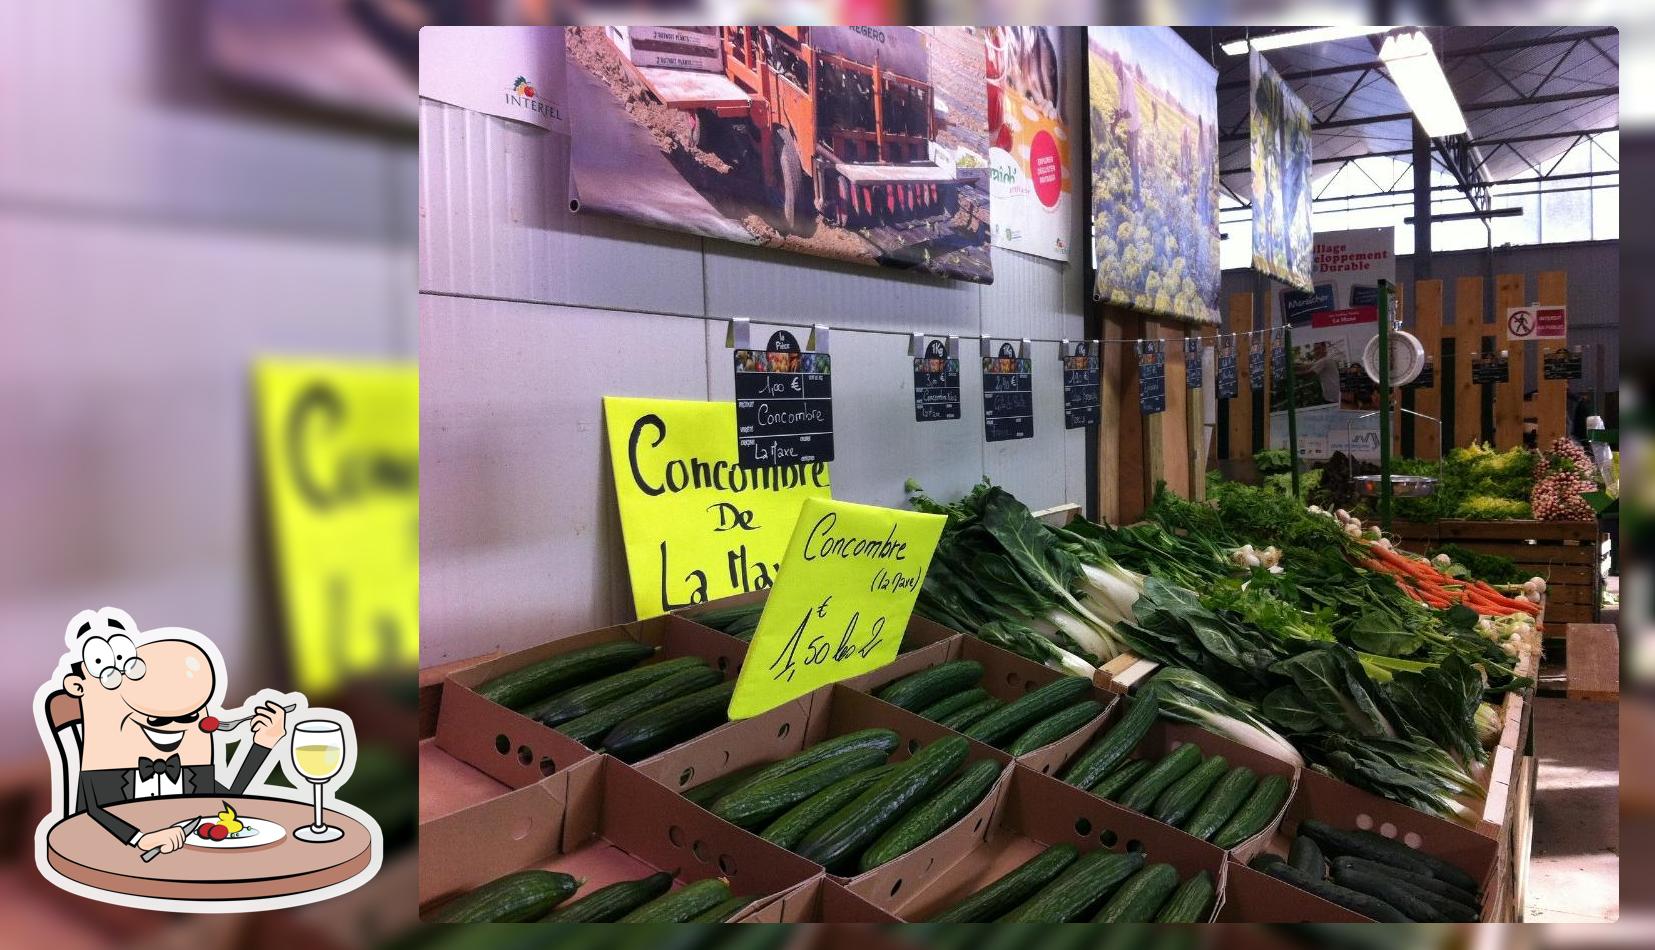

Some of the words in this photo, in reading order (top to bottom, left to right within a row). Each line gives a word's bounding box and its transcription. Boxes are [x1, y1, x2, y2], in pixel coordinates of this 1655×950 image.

[505, 93, 562, 121] INTERFEL
[1320, 261, 1370, 273] Durable
[790, 376, 802, 392] €
[758, 402, 825, 426] Concombre
[754, 443, 768, 460] La
[706, 502, 762, 532] De
[804, 512, 907, 561] Concombre
[660, 541, 709, 612] La
[728, 545, 780, 593] Ma
